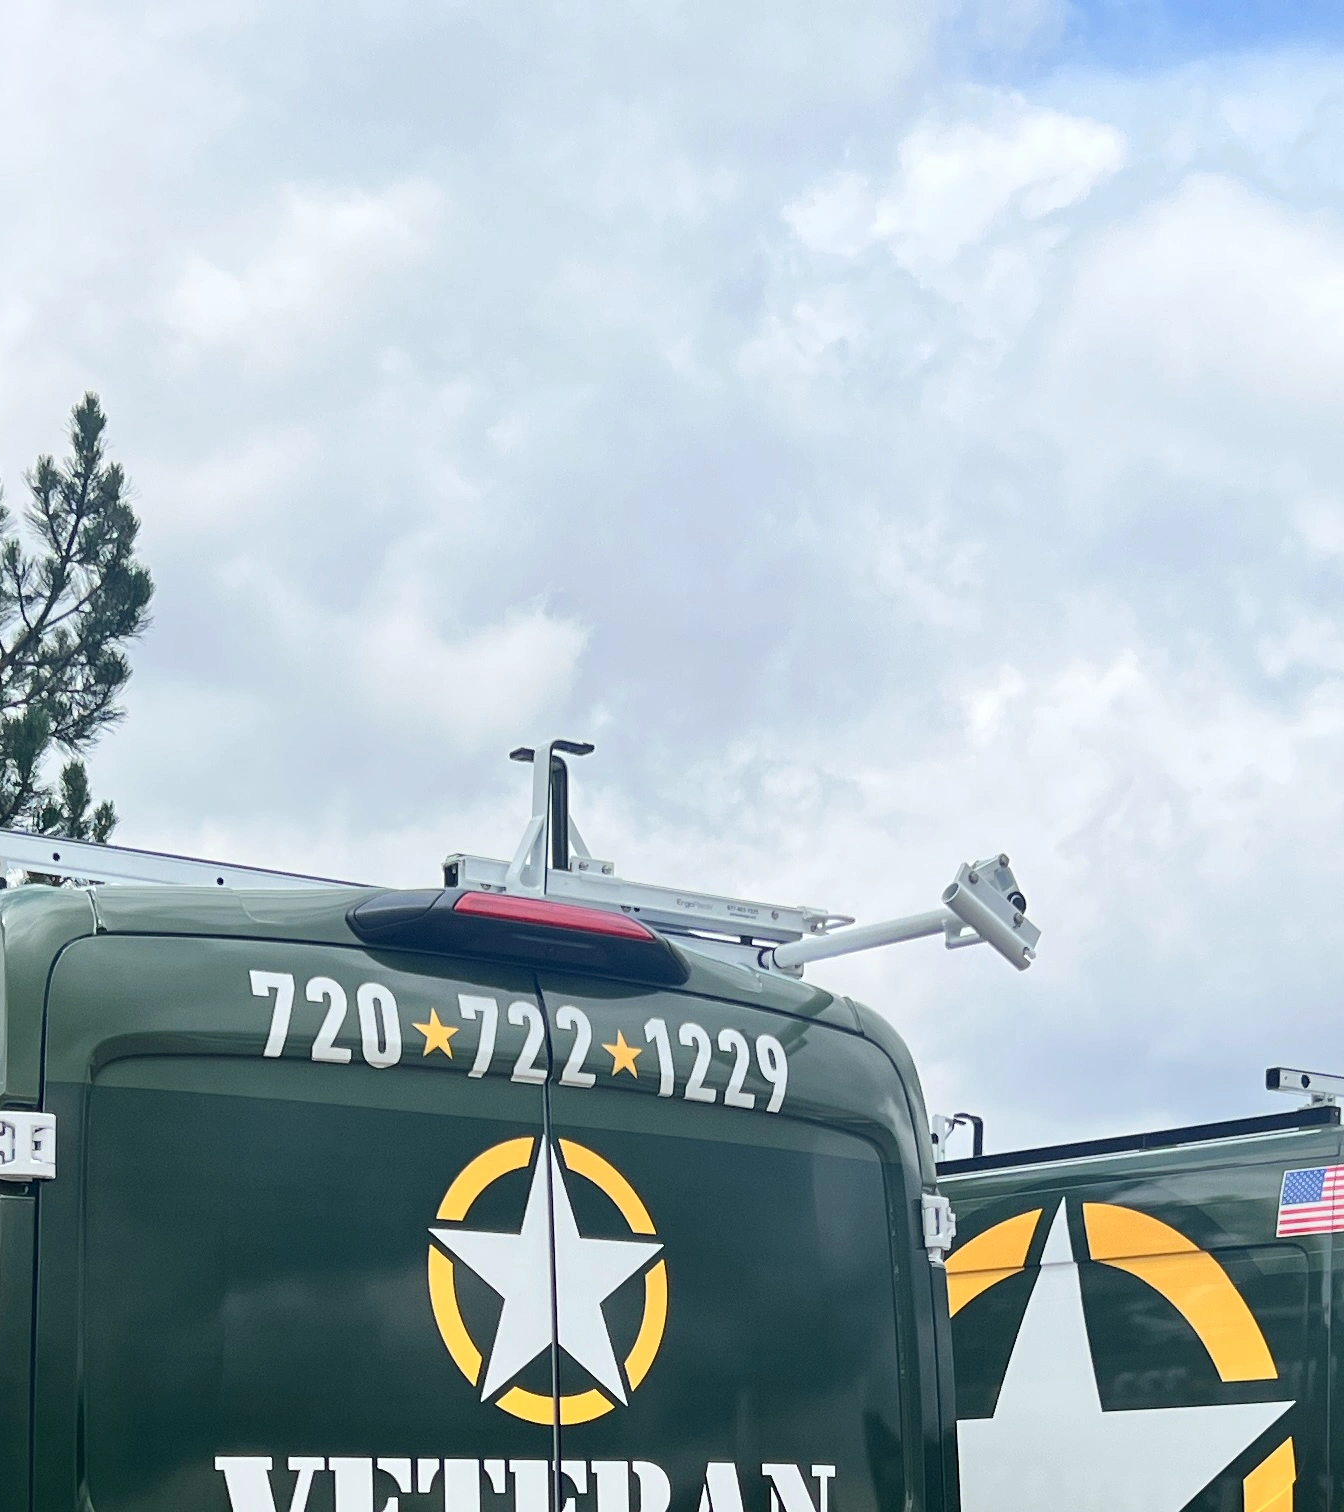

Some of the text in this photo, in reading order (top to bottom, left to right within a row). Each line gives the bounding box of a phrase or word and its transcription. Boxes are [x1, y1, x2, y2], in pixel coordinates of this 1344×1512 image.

[249, 970, 789, 1114] 720 722 1229
